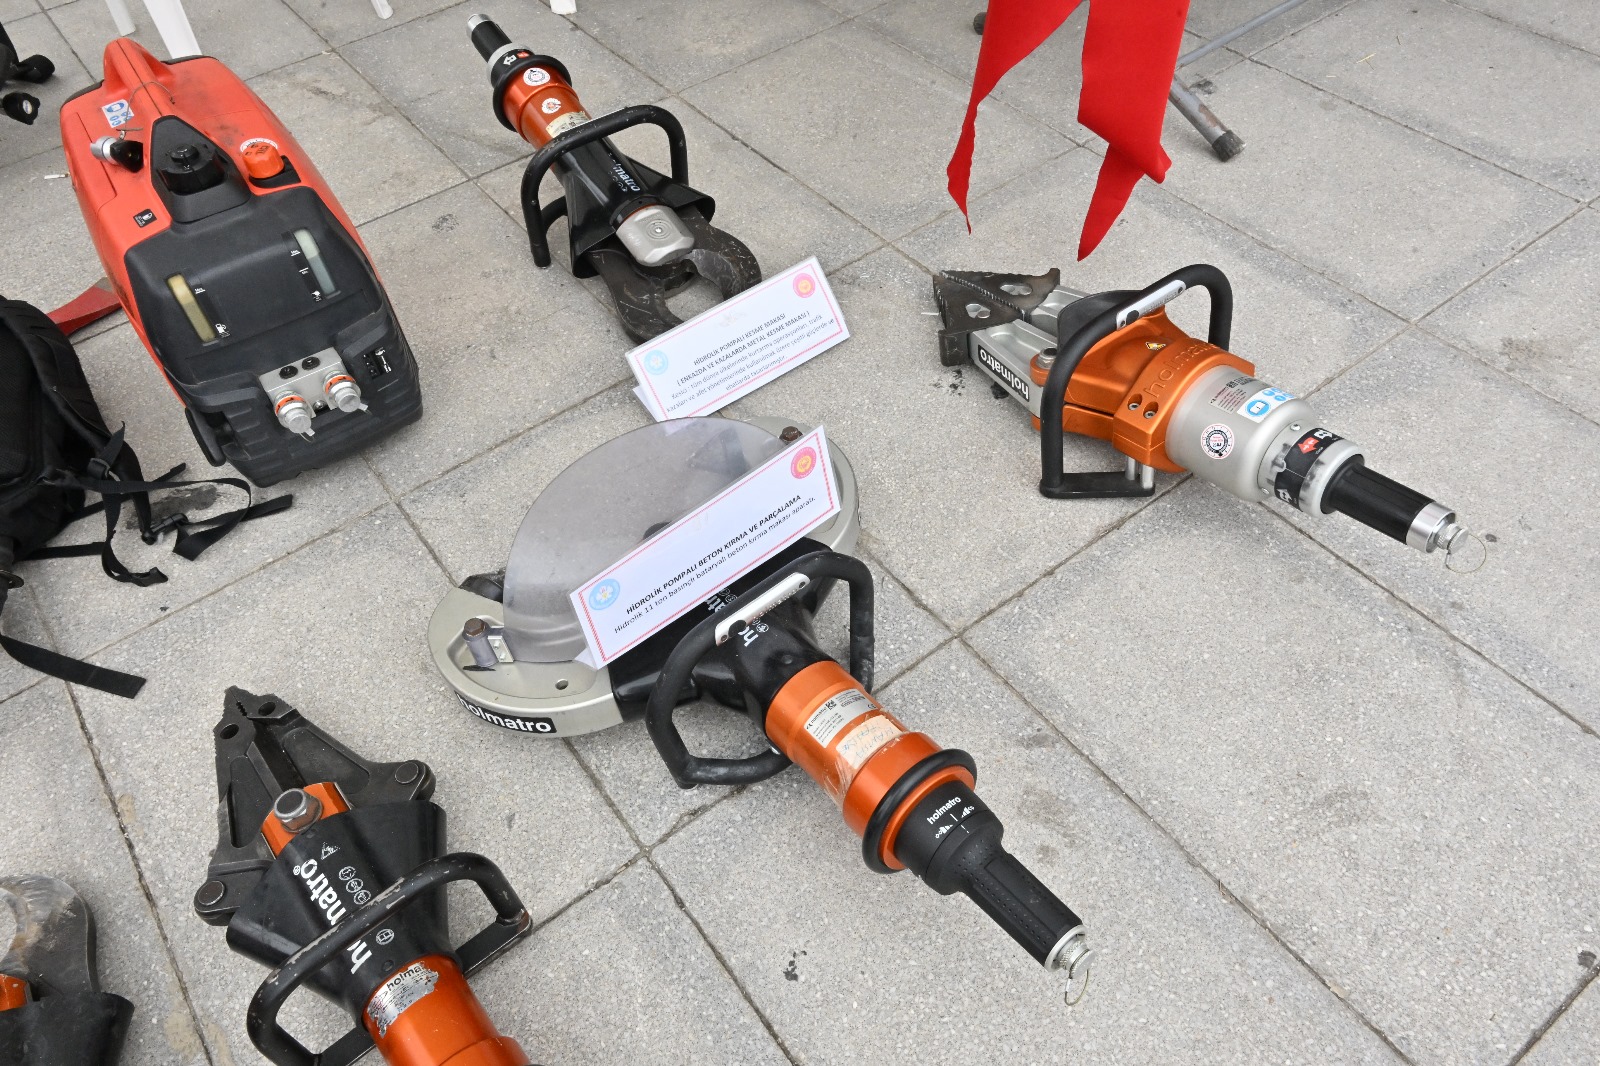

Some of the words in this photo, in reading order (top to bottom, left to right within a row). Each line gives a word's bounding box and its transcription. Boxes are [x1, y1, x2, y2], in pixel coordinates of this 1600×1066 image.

[746, 325, 763, 338] KESME
[765, 313, 785, 327] MAKASI
[681, 366, 706, 383] ENKAZDA
[748, 335, 765, 347] METAL
[767, 324, 784, 336] KESME
[980, 349, 1029, 400] holmatro
[614, 611, 643, 632] Hidrolik
[644, 604, 652, 612] 11
[655, 595, 668, 605] ton
[696, 556, 726, 578] bataryalı
[727, 542, 747, 557] beton
[748, 529, 767, 544] kırma
[768, 513, 790, 530] makası
[626, 587, 662, 613] HİDROLİK
[663, 564, 697, 588] POMPALI
[698, 547, 723, 566] BETON
[724, 531, 747, 549] KIRMA
[759, 495, 802, 526] PARÇALAMA
[457, 693, 552, 733] holmatro
[926, 796, 962, 825] holmatro
